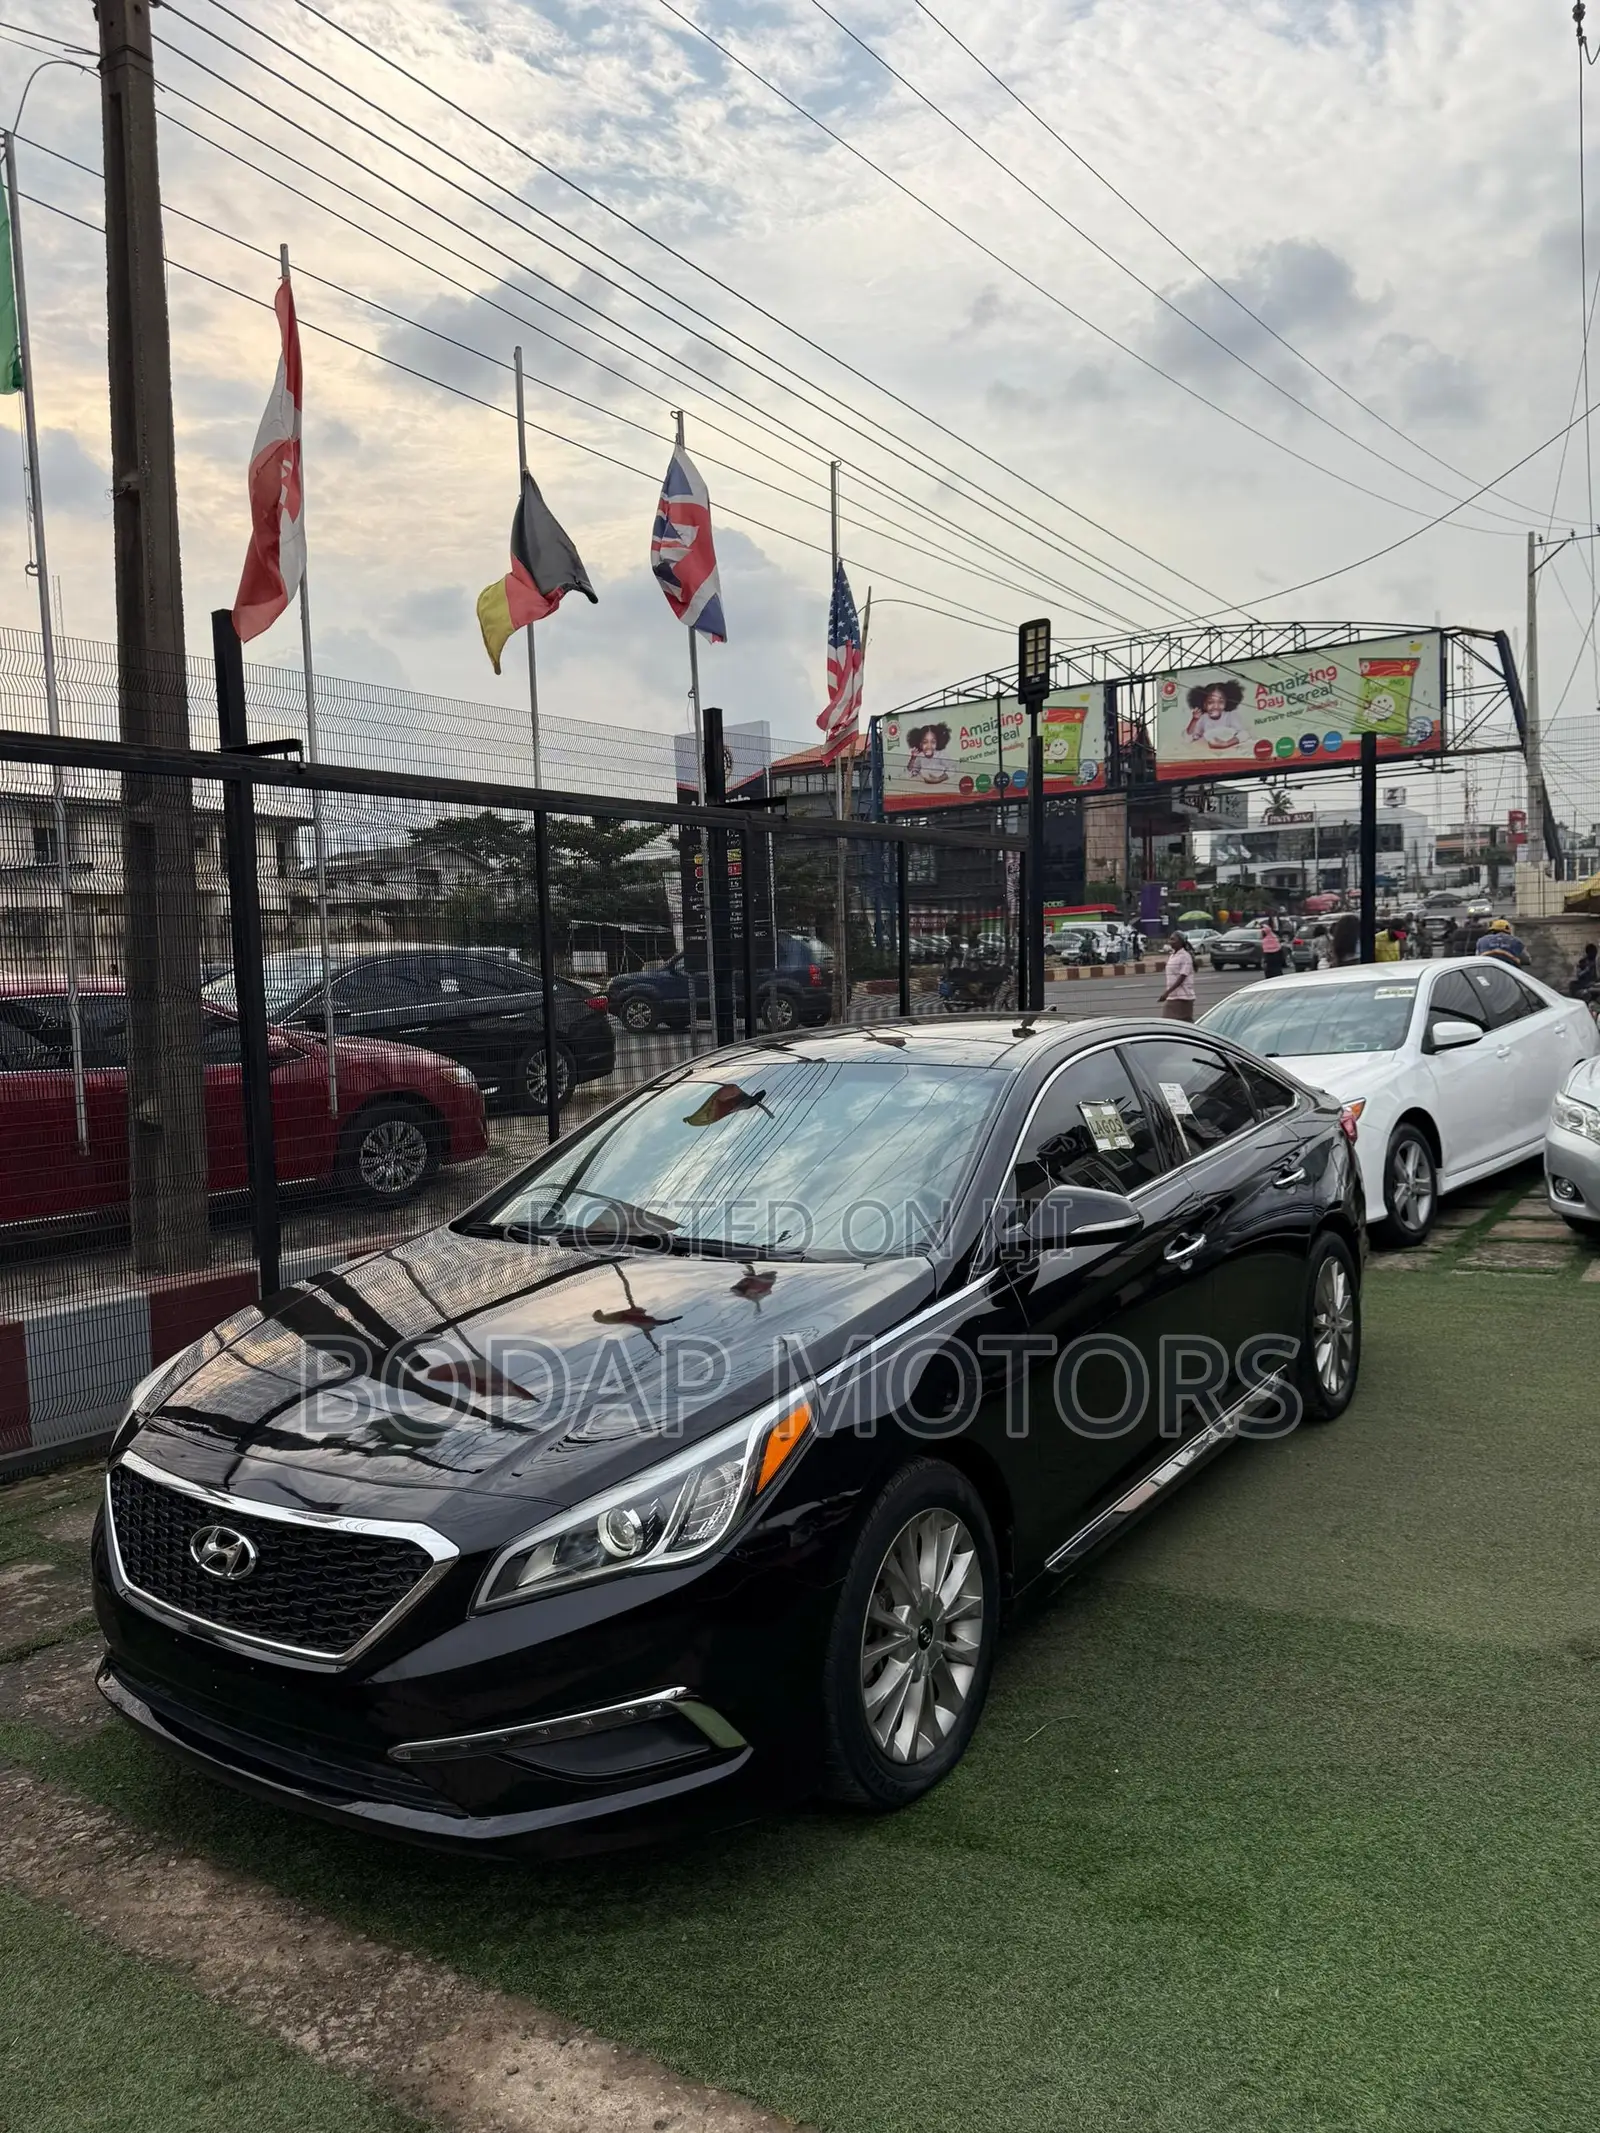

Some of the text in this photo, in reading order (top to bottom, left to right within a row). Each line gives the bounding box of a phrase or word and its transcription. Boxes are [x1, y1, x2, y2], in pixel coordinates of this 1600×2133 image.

[1255, 665, 1337, 698] Amaizing
[1256, 696, 1284, 711] Day
[1286, 680, 1332, 705] Cereal
[960, 737, 983, 750] Day
[1089, 1118, 1124, 1136] LAGOS
